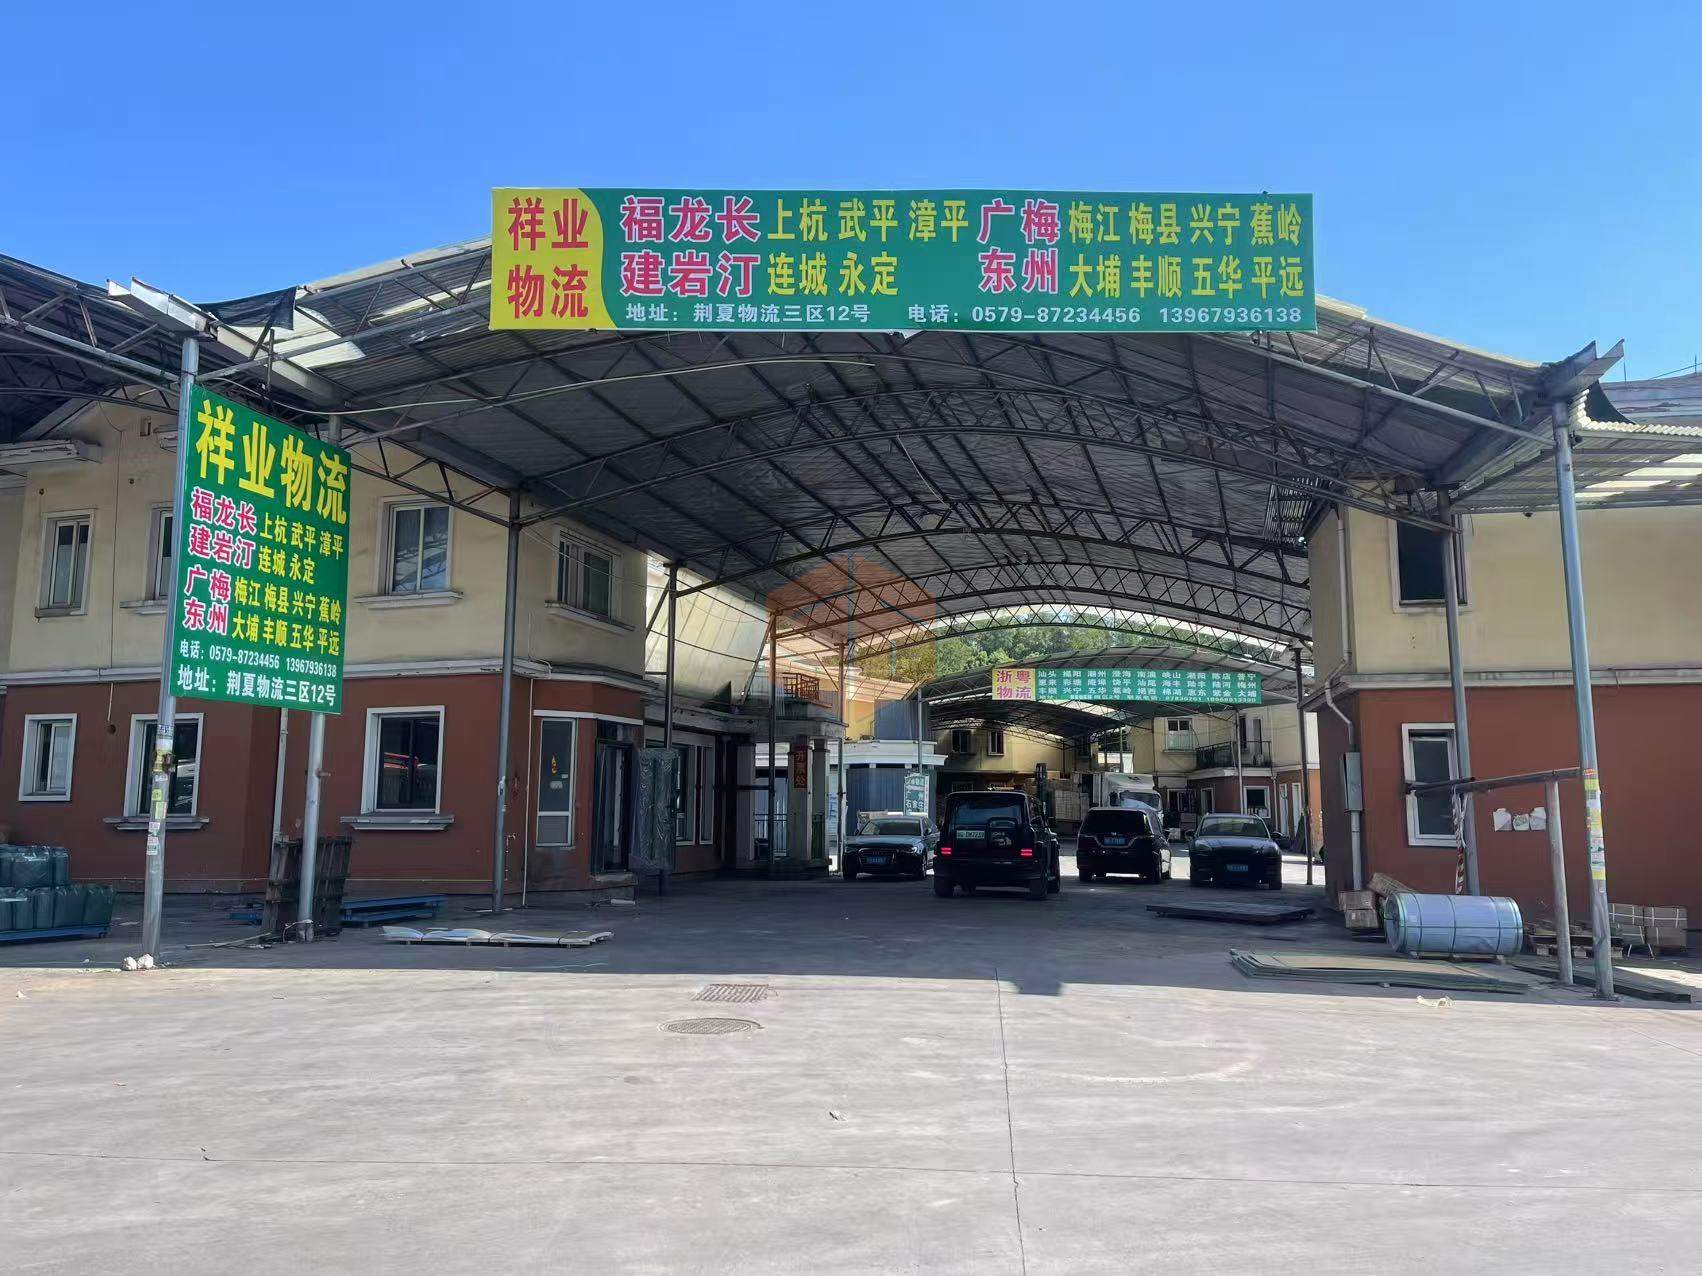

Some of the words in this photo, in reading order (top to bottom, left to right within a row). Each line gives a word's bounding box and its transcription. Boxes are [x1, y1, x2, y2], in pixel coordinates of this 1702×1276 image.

[508, 197, 588, 251] 祥业
[767, 198, 829, 242] 上杭
[838, 198, 898, 242] 武平
[908, 199, 969, 243] 漳平
[1068, 202, 1121, 245] 梅江
[1129, 202, 1181, 245] 梅县
[1189, 202, 1241, 246] 兴宁
[1250, 203, 1302, 247] 蕉岭
[507, 263, 588, 319] 物流
[767, 251, 828, 296] 连城
[838, 251, 898, 296] 永定
[1068, 254, 1121, 298] 大埔
[1130, 254, 1182, 298] 丰顺
[1191, 254, 1242, 299] 五华
[1251, 255, 1304, 299] 平远
[1159, 306, 1302, 323] 13967936138
[195, 399, 348, 525] 祥业物流
[259, 511, 288, 545] 上杭
[290, 519, 316, 552] 武平
[319, 530, 344, 560] 漳平
[258, 544, 286, 579] 连城
[289, 551, 315, 586] 永定
[234, 575, 261, 608] 梅江
[264, 582, 290, 615] 梅县
[292, 590, 316, 620] 兴宁
[319, 596, 342, 627] 蕉岭
[231, 610, 259, 644] 大埔
[262, 617, 288, 648] 丰顺
[290, 622, 315, 653] 五华
[317, 629, 340, 657] 平远
[286, 657, 337, 678] 13967936138
[996, 669, 1032, 684] 浙粤
[996, 686, 1032, 700] 物流
